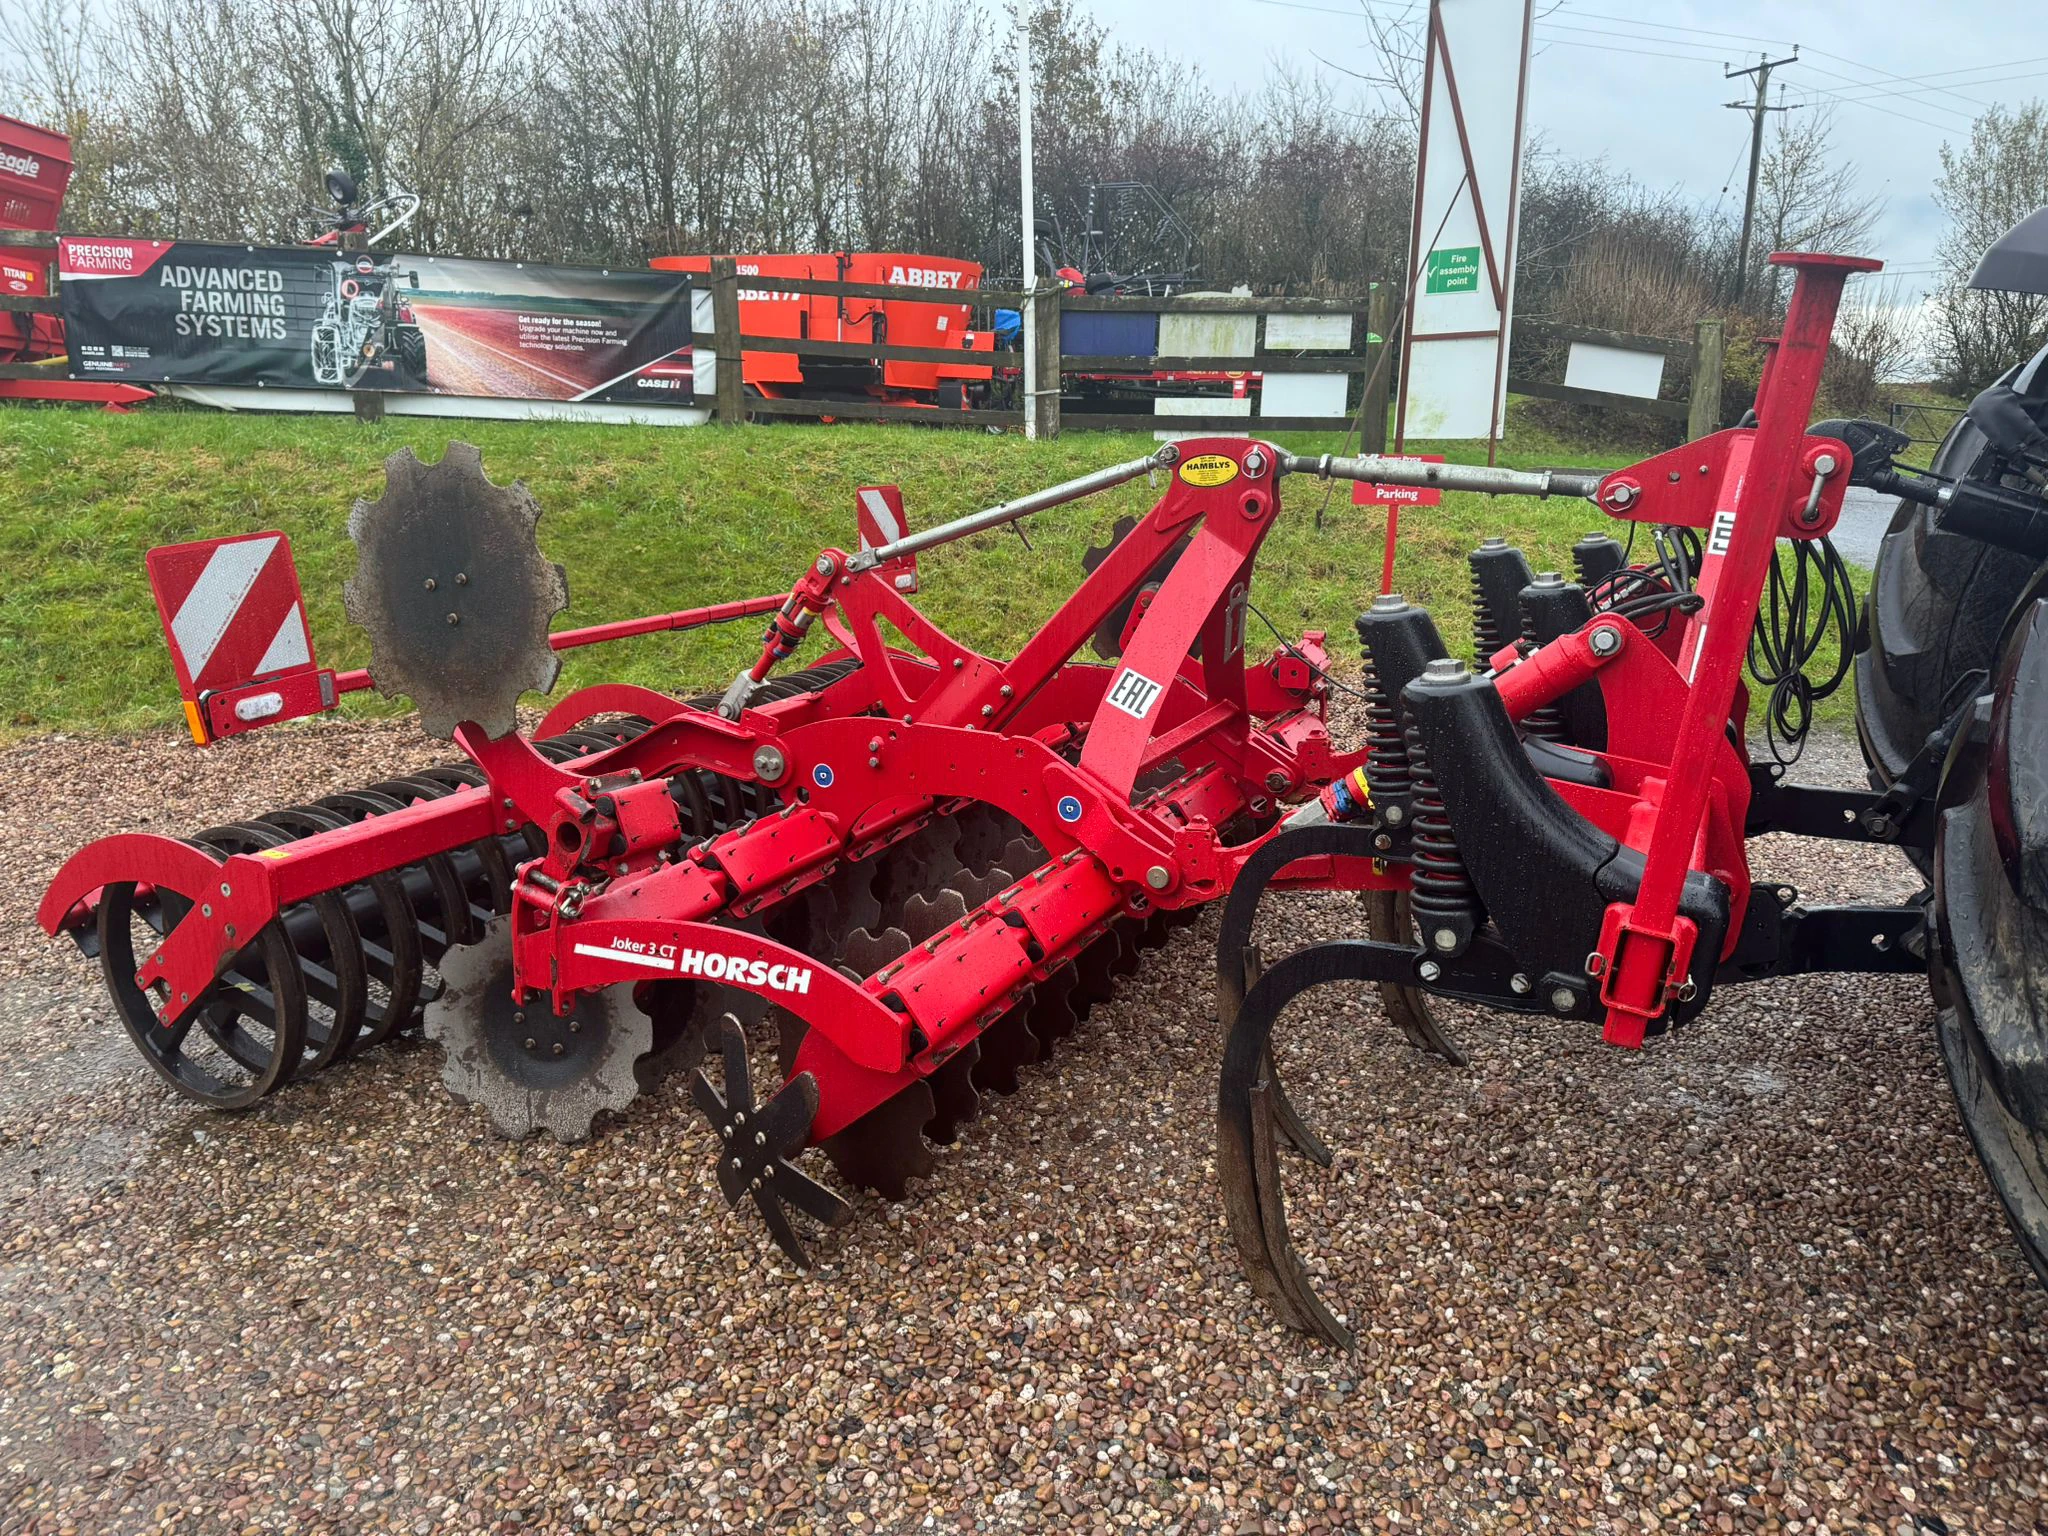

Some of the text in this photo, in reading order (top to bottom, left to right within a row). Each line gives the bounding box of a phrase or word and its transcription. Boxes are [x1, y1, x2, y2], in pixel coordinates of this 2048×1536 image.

[0, 152, 40, 176] eagle
[68, 244, 133, 258] PRECISION
[69, 255, 132, 270] FARMING
[1451, 255, 1467, 263] Fire
[3, 267, 26, 280] TITAN
[1439, 265, 1477, 275] assembly
[160, 265, 283, 292] ADVANCED
[888, 265, 962, 289] ABBEY
[1446, 277, 1468, 288] point
[181, 290, 285, 316] FARMING
[175, 313, 287, 340] SYSTEMS
[518, 315, 602, 328] Get ready for the season!
[519, 325, 546, 333] Upgrade
[562, 327, 590, 335] machine
[519, 342, 553, 350] technology
[571, 335, 601, 343] Precision
[602, 337, 628, 346] Farming
[83, 360, 113, 368] GENUINE
[637, 378, 670, 389] CASE
[1186, 461, 1231, 471] HAMBLYS
[1376, 488, 1419, 502] Parking
[1110, 671, 1158, 715] EAC
[610, 936, 812, 994] Joker 3 CT HORSCH
